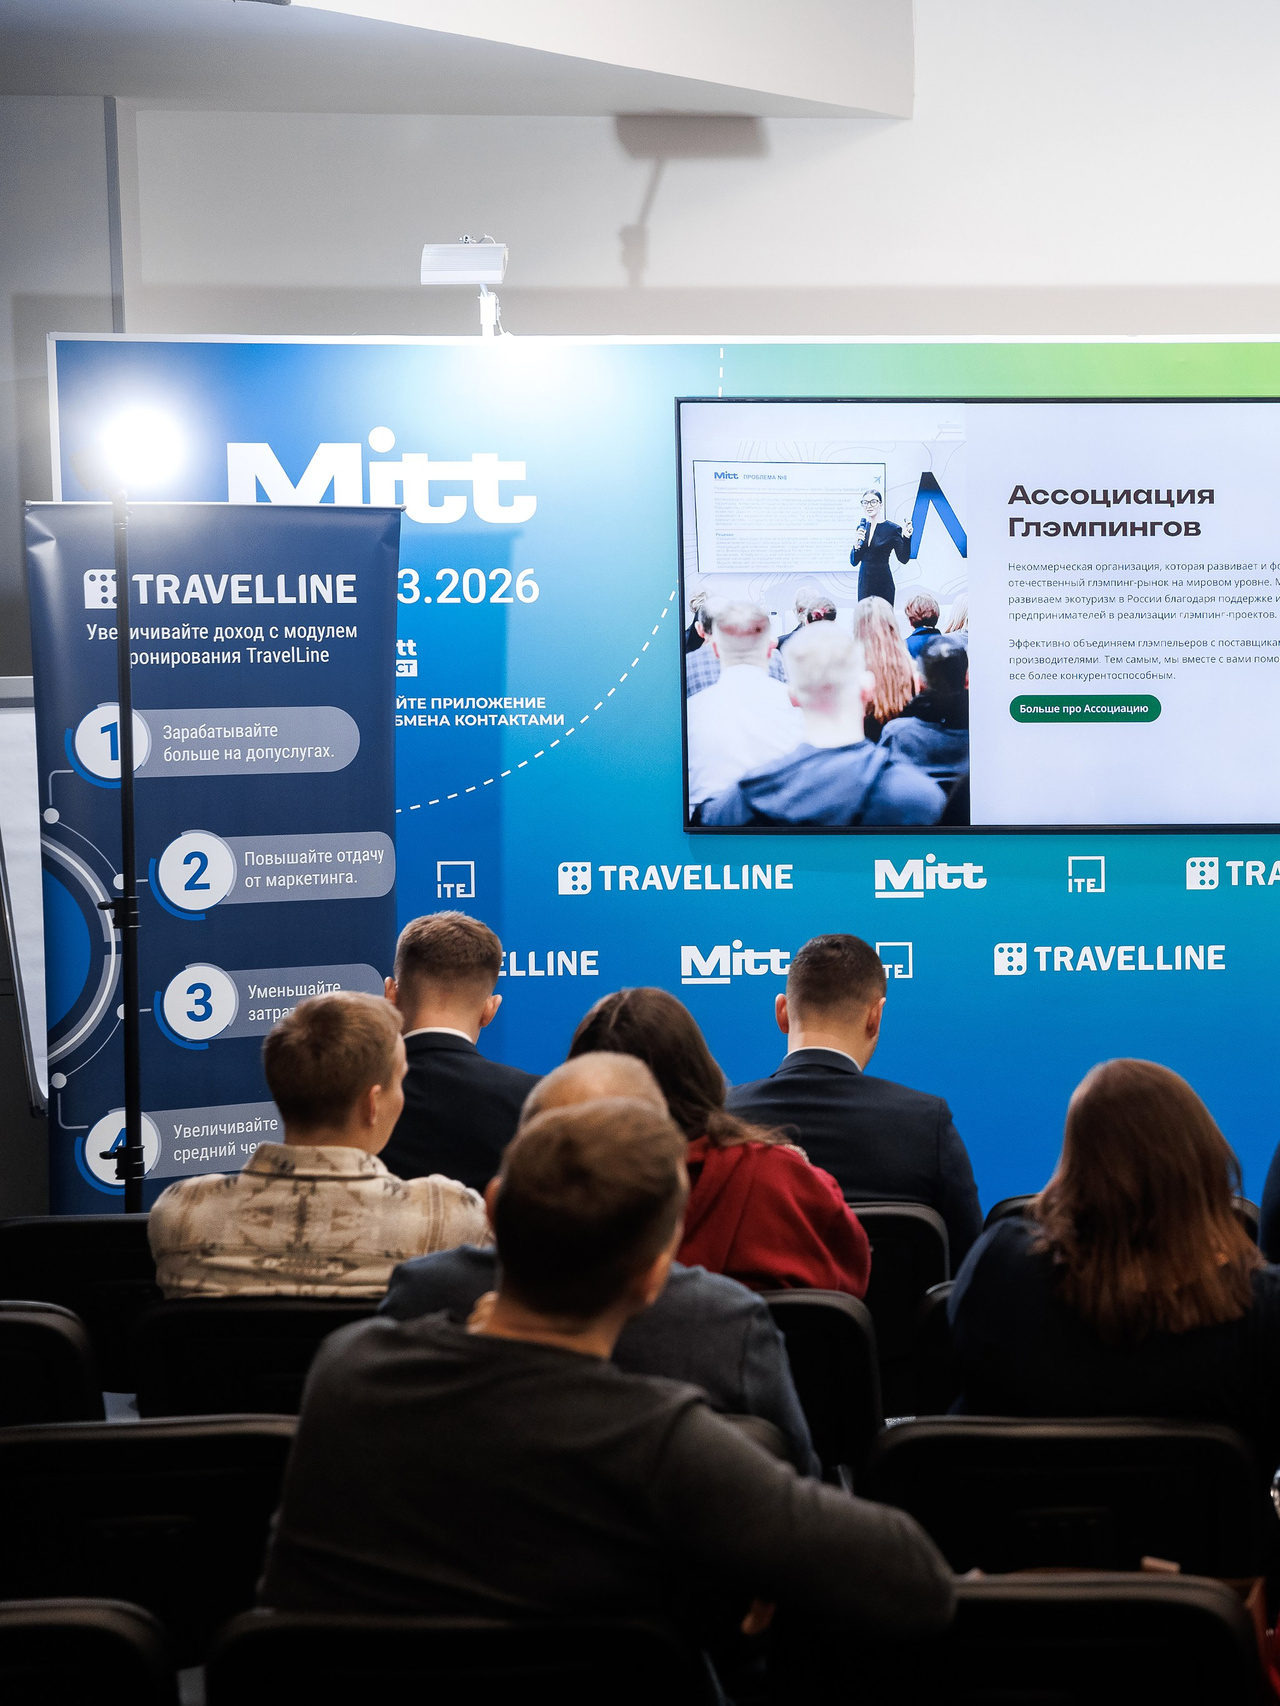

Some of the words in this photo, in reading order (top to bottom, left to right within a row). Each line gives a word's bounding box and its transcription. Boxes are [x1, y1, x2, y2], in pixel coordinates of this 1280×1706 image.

[227, 426, 537, 523] Mitt
[1008, 485, 1214, 508] Ассоциация
[1009, 517, 1202, 537] Глэмпингов
[1008, 563, 1093, 573] Некоммерческая
[1095, 563, 1162, 573] организация,
[1165, 564, 1205, 573] которая
[1207, 563, 1258, 572] развивает
[1261, 563, 1267, 571] и
[131, 574, 358, 605] TRAVELLINE
[1008, 578, 1085, 588] отечественный
[1087, 579, 1169, 589] глэмпинг-рынок
[1186, 579, 1232, 588] мировом
[1234, 579, 1273, 588] уровне.
[1008, 596, 1062, 605] развиваем
[1065, 596, 1116, 606] экотуризм
[1127, 594, 1162, 604] России
[1164, 594, 1216, 605] благодаря
[1218, 595, 1273, 605] поддержке
[1008, 611, 1107, 621] предпринимателей
[1117, 612, 1177, 621] реализации
[1179, 611, 1277, 621] глэмпинг-проектов.
[86, 623, 209, 641] Увеичивайте
[213, 625, 264, 642] доход
[269, 628, 279, 639] с
[284, 625, 358, 642] модулем
[1008, 638, 1071, 649] Эффективно
[1073, 638, 1136, 649] объединяем
[1138, 639, 1208, 648] глэмпельеров
[129, 650, 241, 668] ронирования
[246, 646, 330, 664] TravelLine
[1104, 655, 1124, 664] Тем
[1125, 656, 1162, 666] самым,
[1164, 656, 1179, 664] мы
[1182, 656, 1216, 664] вместе
[1218, 656, 1224, 664] с
[1009, 672, 1026, 680] все
[1028, 671, 1058, 680] более
[1060, 671, 1176, 682] конкурентоспособным.
[431, 697, 546, 710] ПРИЛОЖЕНИЕ
[1020, 703, 1060, 714] Больше
[1063, 705, 1082, 717] про
[1084, 703, 1149, 716] Ассоциацию
[455, 714, 565, 727] КОНТАКТАМИ
[163, 723, 278, 742] Зарабатывайте
[163, 747, 220, 762] больше
[224, 749, 241, 761] на
[246, 746, 335, 763] допуслугах.
[244, 849, 333, 867] Повышайте
[337, 847, 385, 865] отдачу
[182, 851, 211, 891] 2
[244, 875, 262, 889] от
[266, 870, 358, 889] маркетинга.
[599, 864, 793, 891] TRAVELLINE
[875, 853, 987, 891] Mitt
[681, 939, 791, 976] Mitt
[1033, 944, 1226, 972] TRAVELLINE
[248, 981, 341, 999] Уменьшайте
[186, 982, 213, 1022] 3
[173, 1117, 279, 1139] Увеличивайте
[173, 1141, 237, 1163] средний
[240, 1142, 261, 1156] че
